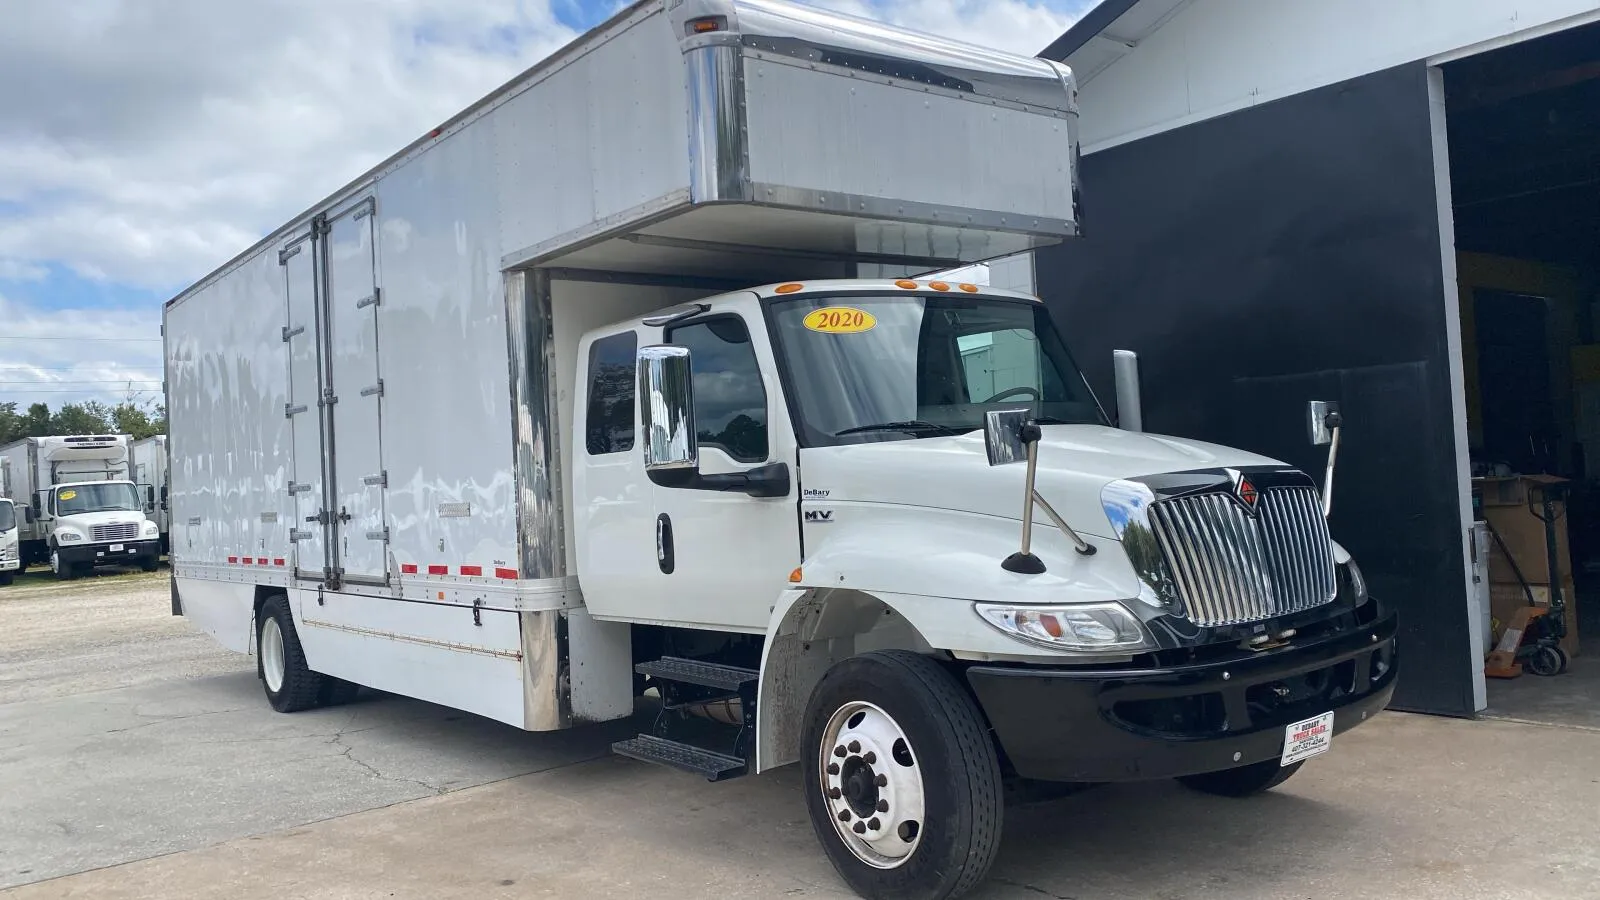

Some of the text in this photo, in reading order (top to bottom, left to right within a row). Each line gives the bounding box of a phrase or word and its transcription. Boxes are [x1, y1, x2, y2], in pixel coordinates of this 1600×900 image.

[817, 311, 864, 329] 2020
[803, 488, 830, 497] DeBary
[804, 510, 833, 520] MV
[1293, 730, 1310, 742] TRUCK
[1311, 724, 1327, 736] SALES
